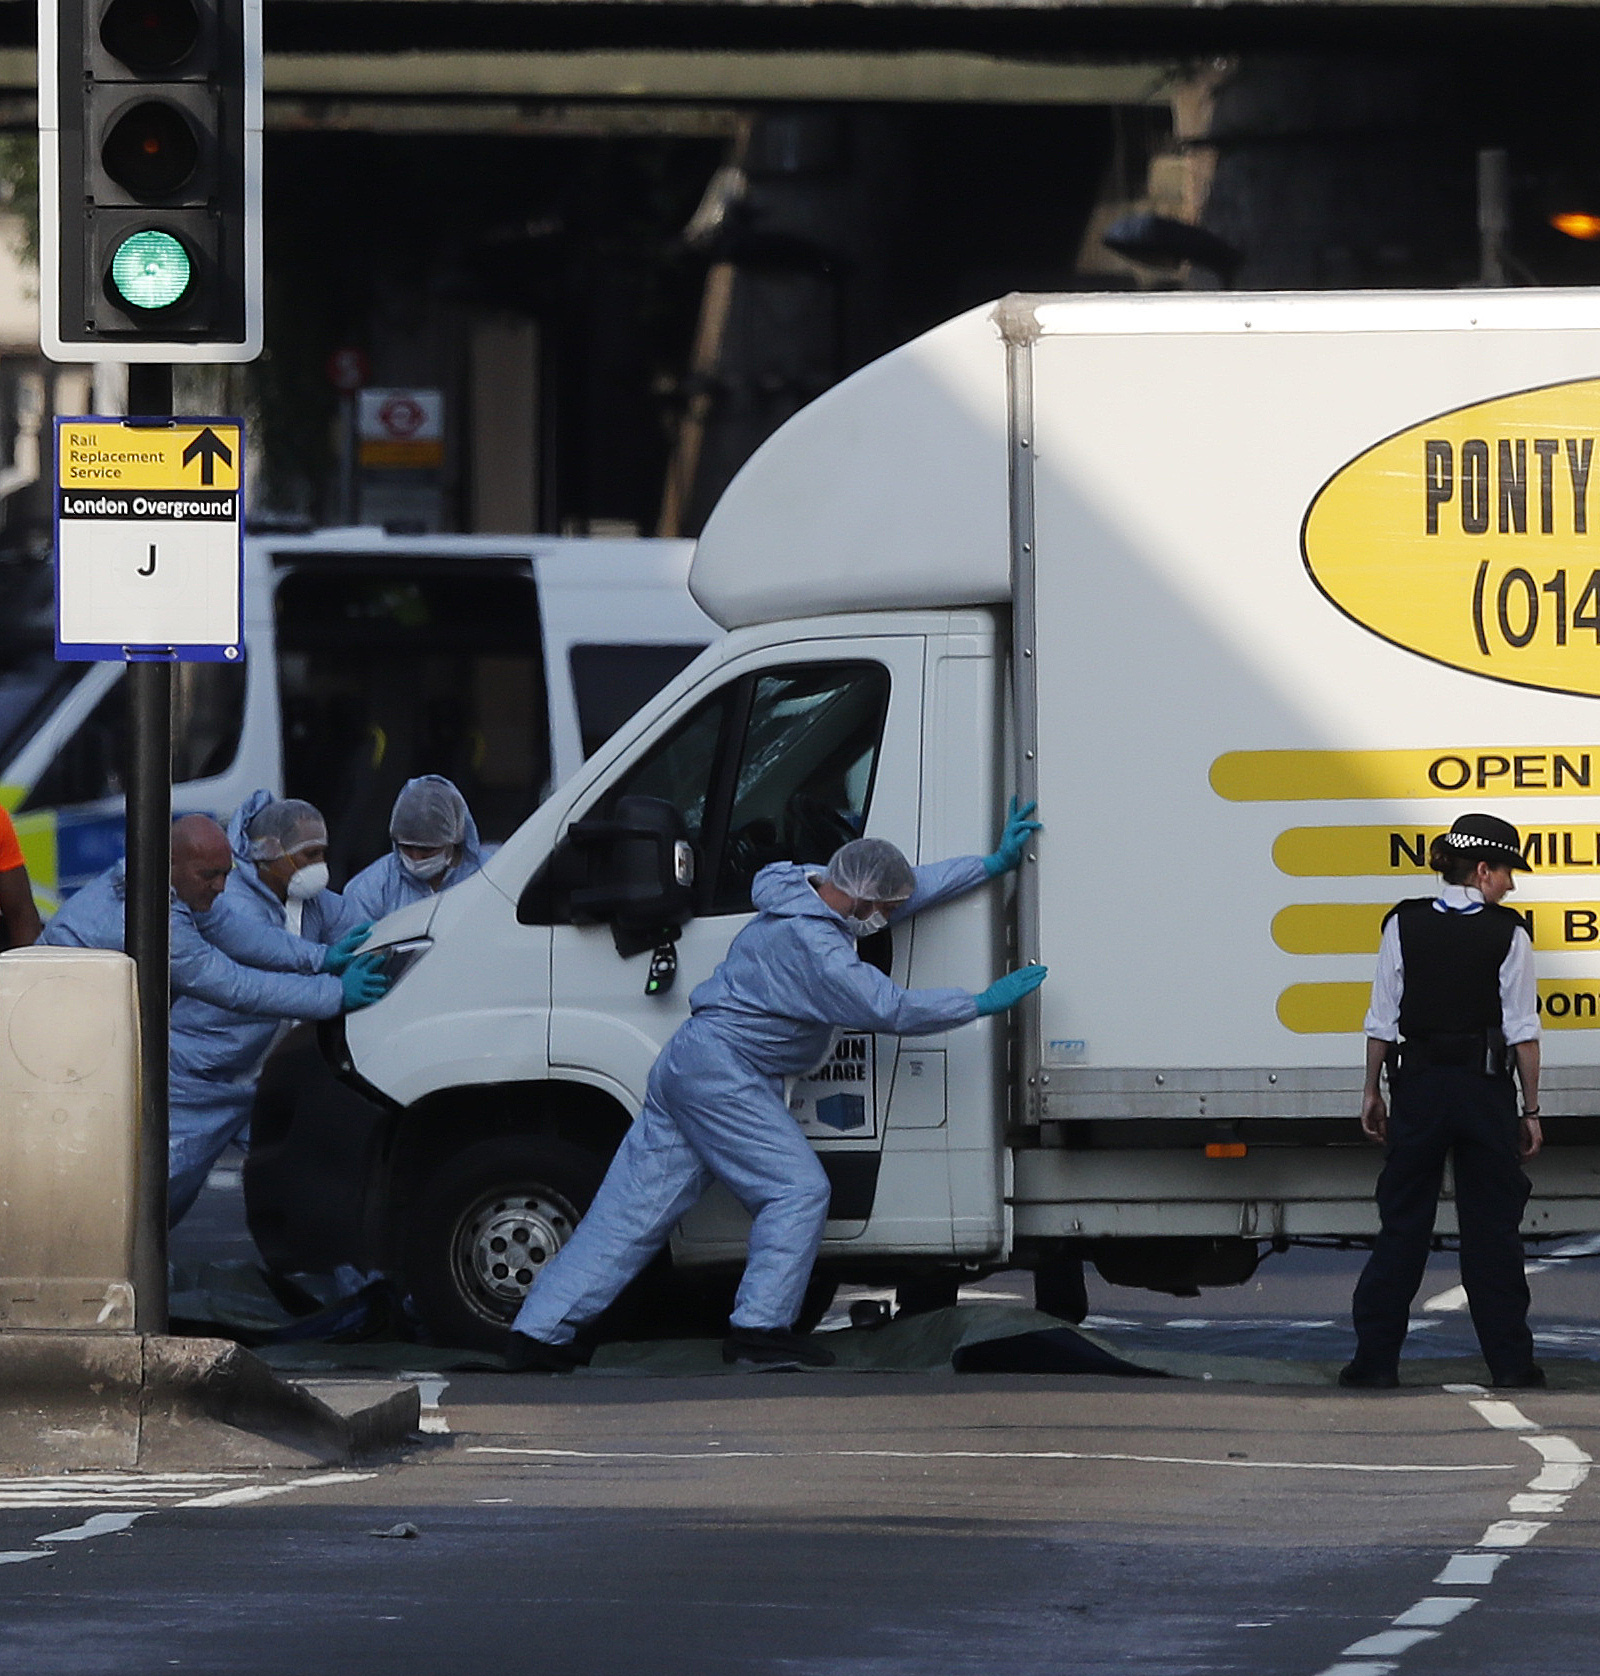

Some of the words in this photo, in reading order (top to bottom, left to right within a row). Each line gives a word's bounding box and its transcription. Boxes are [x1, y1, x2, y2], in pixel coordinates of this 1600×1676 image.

[70, 434, 97, 446] Rail
[70, 450, 165, 465] Replacement
[70, 466, 122, 479] Service
[64, 496, 128, 515] London
[132, 497, 233, 519] Overground
[136, 543, 156, 577] J
[1428, 754, 1590, 790] OPEN
[1389, 833, 1432, 868] N
